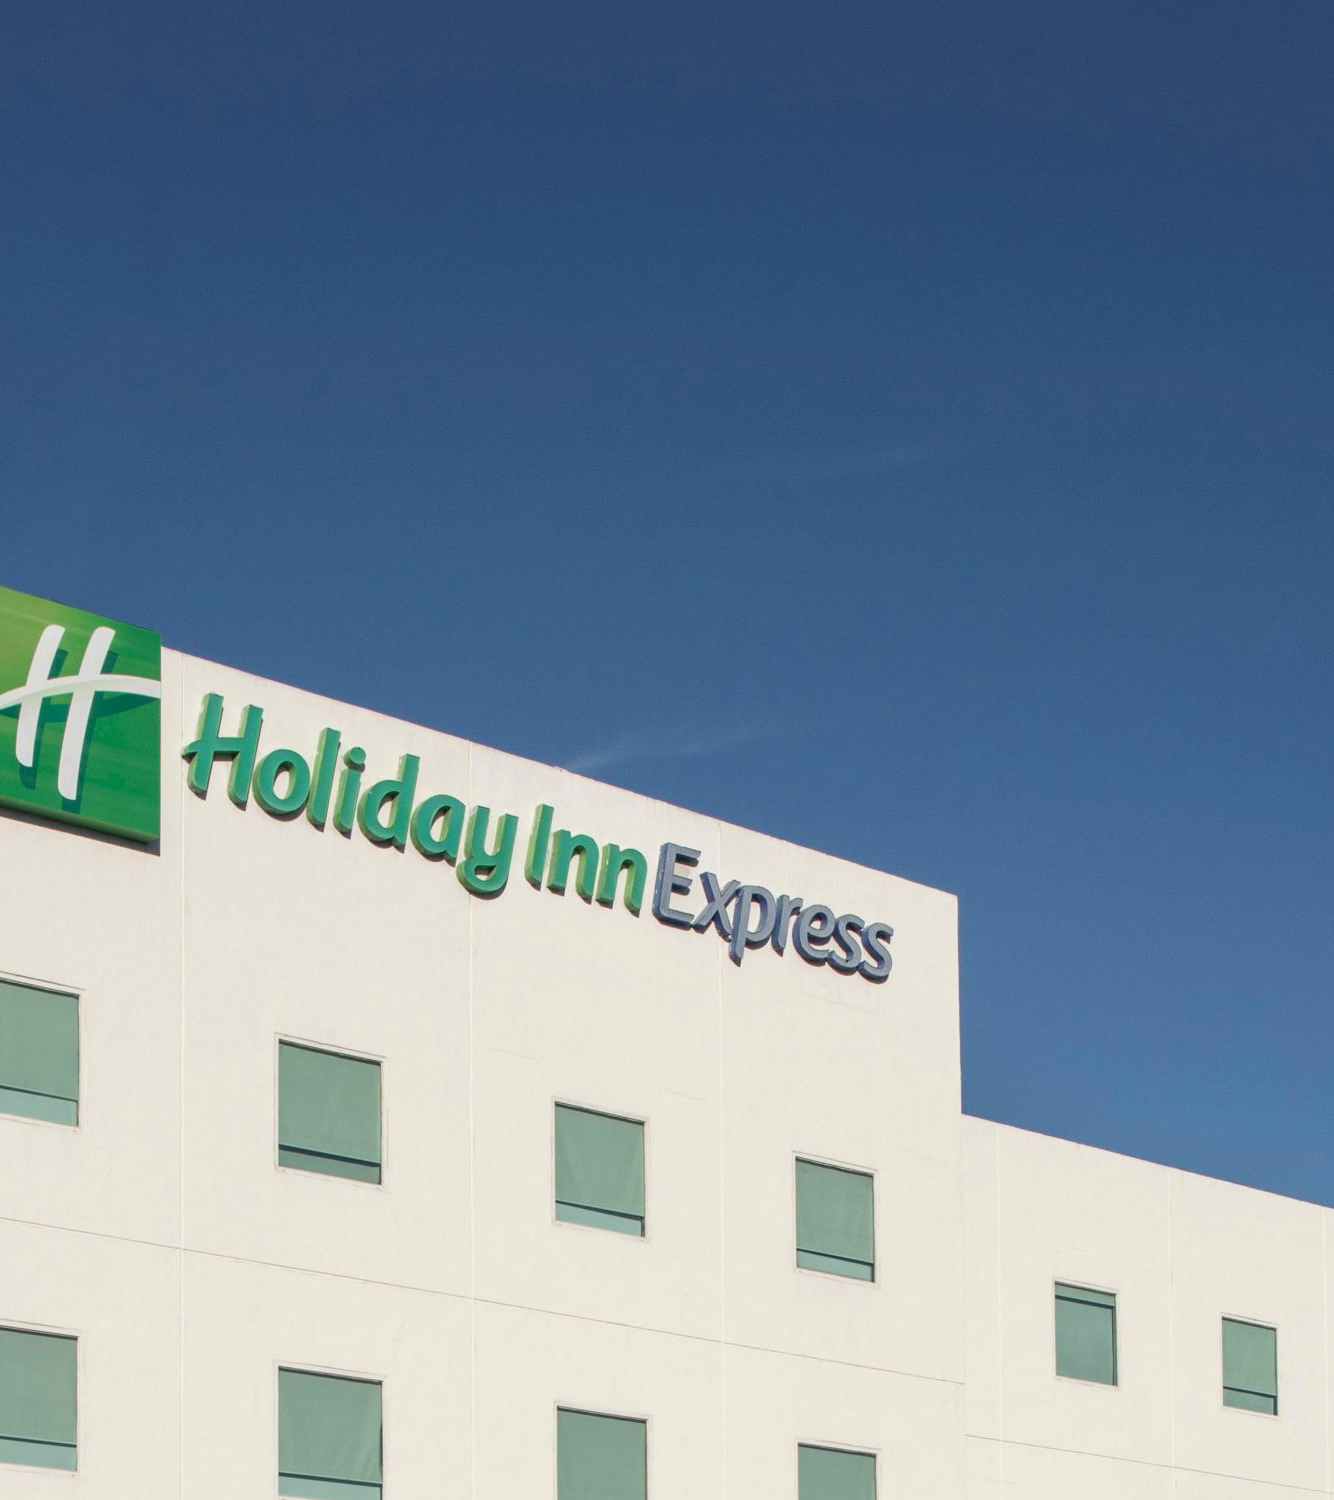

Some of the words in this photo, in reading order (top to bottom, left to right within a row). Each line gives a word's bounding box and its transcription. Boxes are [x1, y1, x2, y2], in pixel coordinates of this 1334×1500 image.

[182, 692, 518, 894] Holiday
[524, 804, 648, 914] Inn
[652, 842, 895, 982] Express
